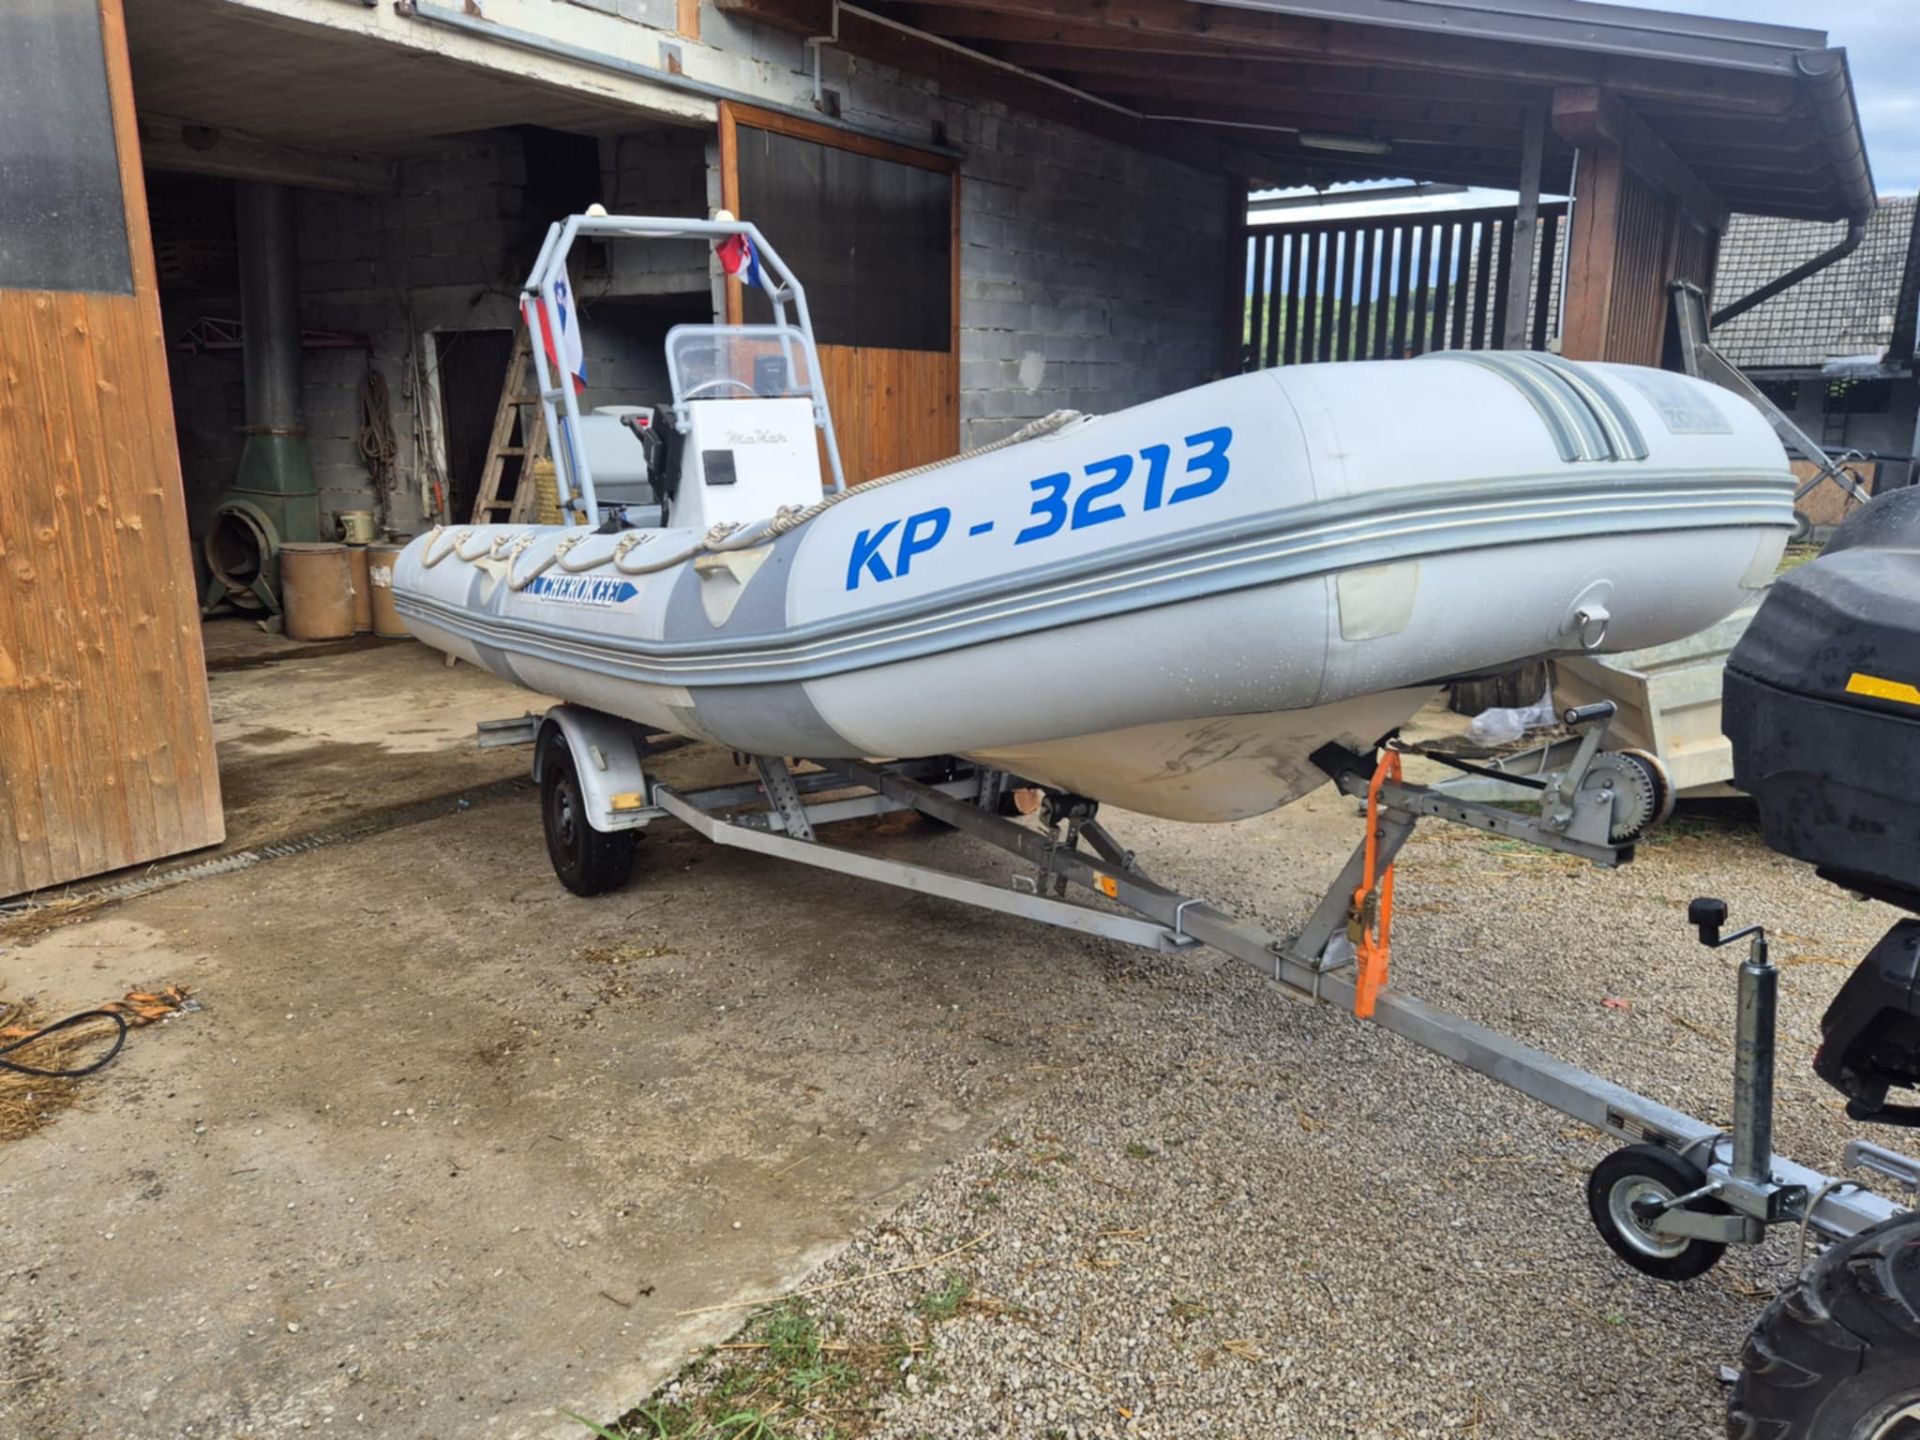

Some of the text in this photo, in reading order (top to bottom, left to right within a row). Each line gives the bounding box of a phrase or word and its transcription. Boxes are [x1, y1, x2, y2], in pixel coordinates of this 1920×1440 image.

[846, 426, 1233, 591] KP - 3213
[540, 575, 621, 606] CHEROKEE
